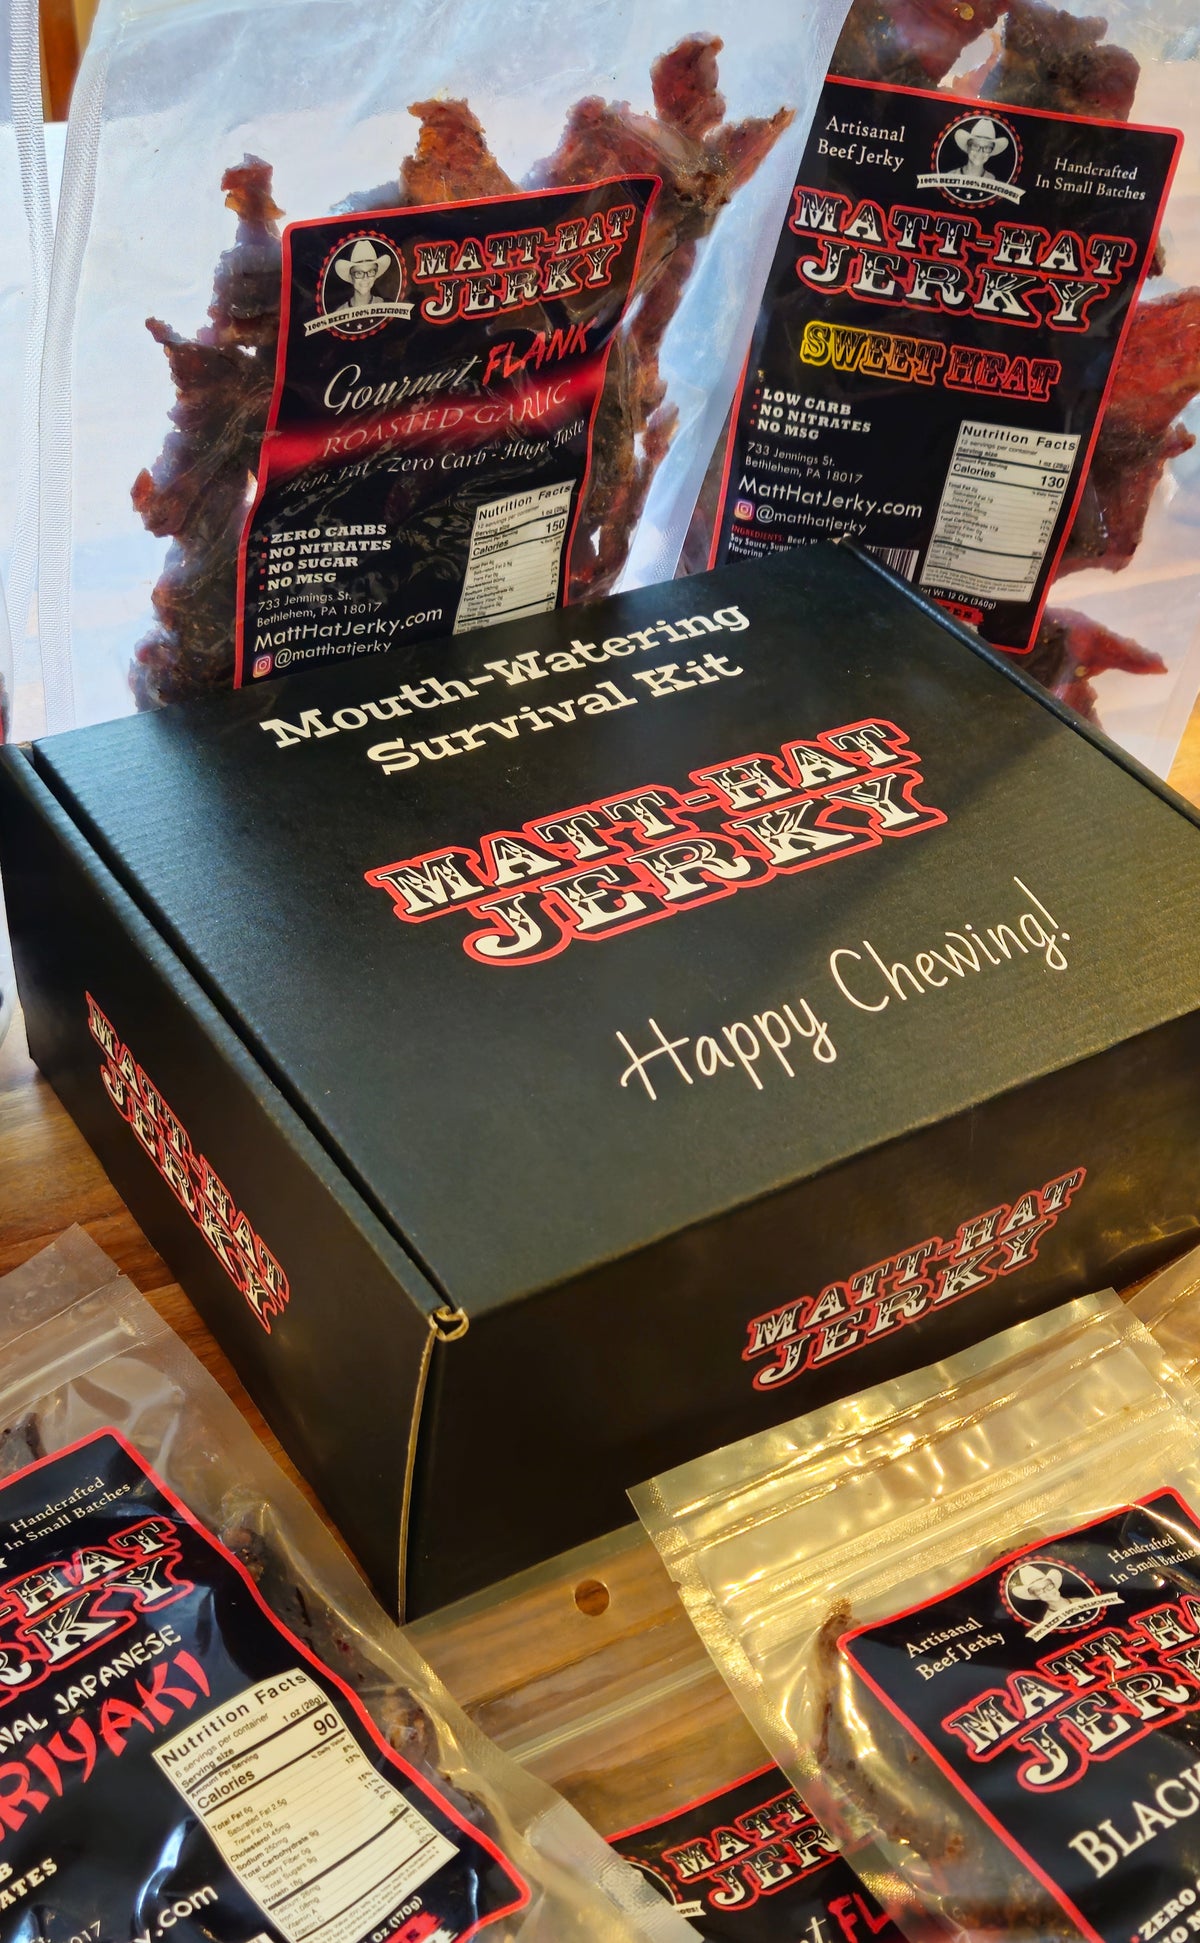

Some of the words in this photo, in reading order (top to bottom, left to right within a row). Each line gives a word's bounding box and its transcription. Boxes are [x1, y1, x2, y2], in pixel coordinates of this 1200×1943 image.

[826, 116, 905, 142] Artisanal
[817, 139, 856, 160] Beef
[857, 147, 905, 171] Jerky
[1054, 158, 1137, 181] Handcrafted
[1036, 174, 1051, 188] In
[1054, 177, 1093, 196] Small
[1096, 184, 1146, 201] Batches
[414, 205, 634, 280] MATT-HAT
[792, 189, 1132, 278] MATT-HAT
[422, 244, 618, 320] JERKY
[799, 240, 1104, 327] JERKY
[307, 319, 328, 331] 100%
[351, 308, 370, 318] 100%
[370, 307, 410, 316] DELICIOUS!
[324, 355, 483, 415] Gourmet
[482, 316, 600, 387] FLANK
[802, 322, 944, 384] SWEET
[945, 346, 1061, 402] HEAT
[321, 407, 466, 458] ROASTED
[473, 379, 572, 426] GARLIC
[760, 403, 784, 418] NO
[787, 408, 872, 433] NITRATES
[762, 388, 801, 407] LOW
[804, 397, 852, 416] CARB
[387, 456, 435, 474] Zero
[441, 446, 485, 470] Carb
[501, 440, 550, 460] Huge
[553, 419, 586, 448] Taste
[757, 418, 780, 433] NO
[784, 423, 820, 440] MSG
[961, 425, 1030, 446] Nutrition
[1035, 435, 1078, 452] Facts
[969, 440, 997, 451] servings
[745, 455, 802, 478] Bethlehem,
[806, 467, 821, 479] PA
[826, 471, 863, 485] 18017
[747, 441, 770, 456] 733
[773, 447, 819, 467] Jennings
[822, 455, 836, 467] St.
[953, 462, 998, 480] Calories
[1040, 474, 1067, 490] 130
[478, 496, 533, 521] Nutrition
[538, 485, 571, 501] Facts
[738, 474, 923, 518] MattHatJerky.com
[271, 528, 321, 544] ZERO
[324, 523, 388, 539] CARBS
[472, 540, 509, 557] Calories
[546, 518, 566, 534] 150
[756, 504, 867, 536] @matthatjerky
[268, 563, 294, 576] NO
[297, 556, 360, 570] SUGAR
[269, 546, 296, 560] NO
[299, 540, 392, 555] NITRATES
[257, 599, 281, 614] 733
[283, 591, 335, 609] Jennings
[336, 590, 352, 602] St.
[267, 578, 293, 592] NO
[295, 571, 338, 585] MSG
[947, 591, 957, 600] 12
[253, 606, 443, 653] MattHatJerky.com
[256, 610, 317, 629] Bethlehem,
[320, 606, 338, 618] PA
[342, 602, 382, 615] 18017
[274, 640, 392, 669] @matthatjerky
[260, 604, 752, 750] Mouth-Watering
[366, 680, 639, 777] Survival
[632, 652, 744, 698] Kit
[368, 720, 918, 921] MATT-HAT
[465, 769, 943, 964] JERKY
[616, 997, 838, 1101] Happy
[828, 876, 1072, 1013] Chewing!
[86, 993, 288, 1312] MATT-HAT
[101, 1063, 270, 1332] JERKY
[743, 1169, 1084, 1360] MATT-HAT
[754, 1215, 1055, 1389] JERKY
[4, 1538, 23, 1551] In
[25, 1515, 73, 1542] Small
[72, 1482, 131, 1520] Batches
[10, 1477, 105, 1532] Handcrafted
[1107, 1533, 1177, 1564] Handcrafted
[1109, 1572, 1129, 1585] In
[1126, 1556, 1160, 1576] Small
[1156, 1548, 1200, 1566] Batche
[905, 1617, 983, 1659] Artisanal
[915, 1649, 960, 1681] Beef
[958, 1631, 1006, 1661] Jerky
[54, 1624, 181, 1715] JAPANESE
[161, 1702, 250, 1768] Nutrition
[253, 1674, 307, 1706] Facts
[181, 1758, 217, 1789] Serving
[217, 1748, 235, 1763] size
[290, 1708, 301, 1720] oz
[301, 1694, 325, 1713] (28g)
[183, 1747, 218, 1774] servings
[218, 1734, 232, 1750] per
[233, 1712, 270, 1739] container
[191, 1774, 219, 1799] Amount
[219, 1766, 232, 1780] Per
[231, 1752, 260, 1771] Serving
[197, 1769, 257, 1810] Calories
[313, 1712, 339, 1737] 90
[211, 1817, 232, 1833] Total
[231, 1811, 244, 1823] Fat
[230, 1835, 272, 1863] Cholesterol
[236, 1852, 265, 1873] Sodium
[242, 1865, 263, 1882] Total
[262, 1834, 310, 1869] Carbohydrate
[371, 1927, 391, 1943] Oz
[389, 1895, 424, 1929] (170g)
[1138, 1888, 1197, 1941] ZERO
